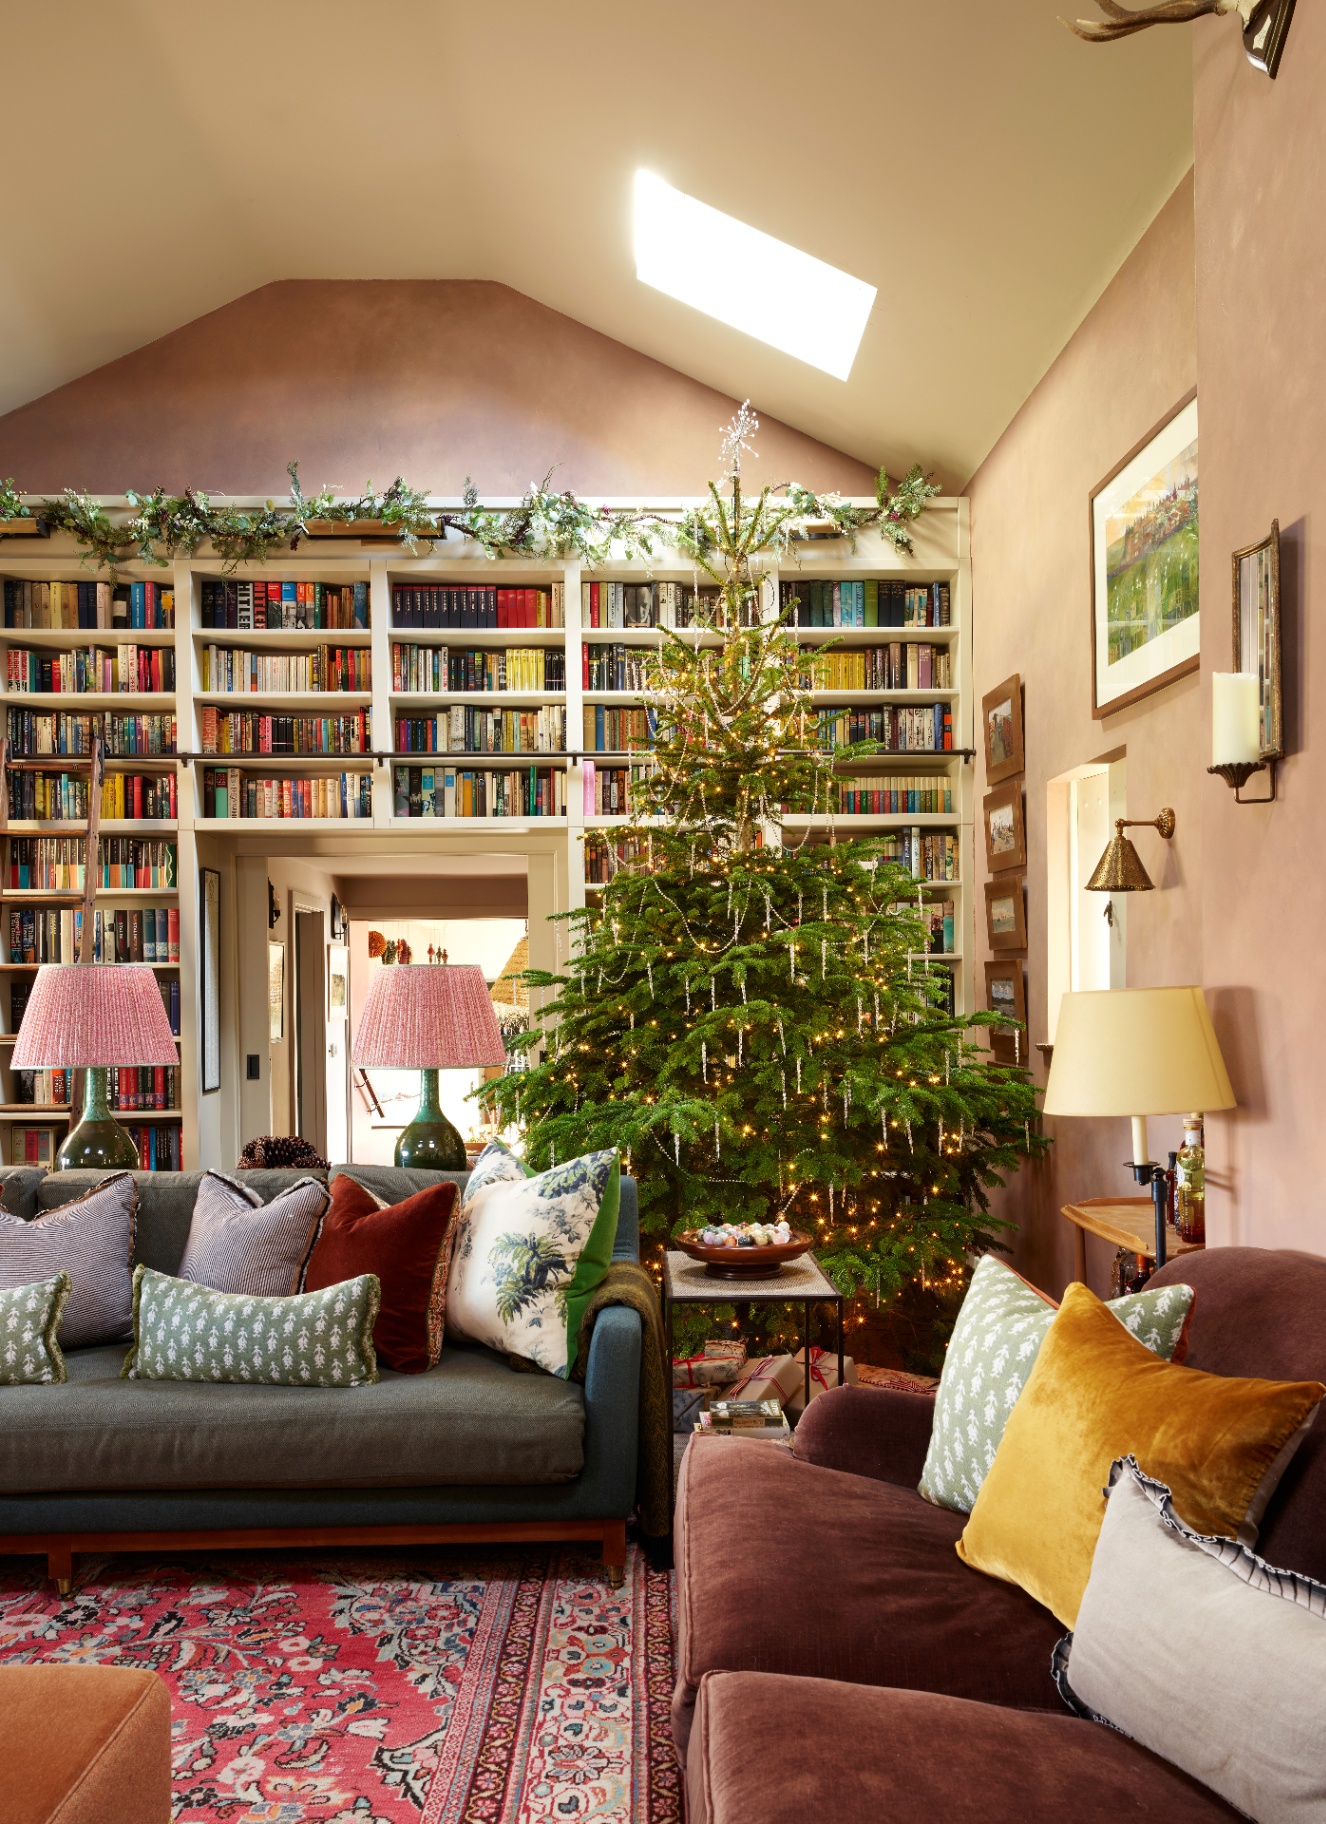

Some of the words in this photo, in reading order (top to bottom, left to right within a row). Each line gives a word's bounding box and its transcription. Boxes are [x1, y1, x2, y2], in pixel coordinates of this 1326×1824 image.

[239, 583, 250, 629] HITLER
[254, 582, 266, 629] HITLER
[283, 790, 291, 813] SCOOP
